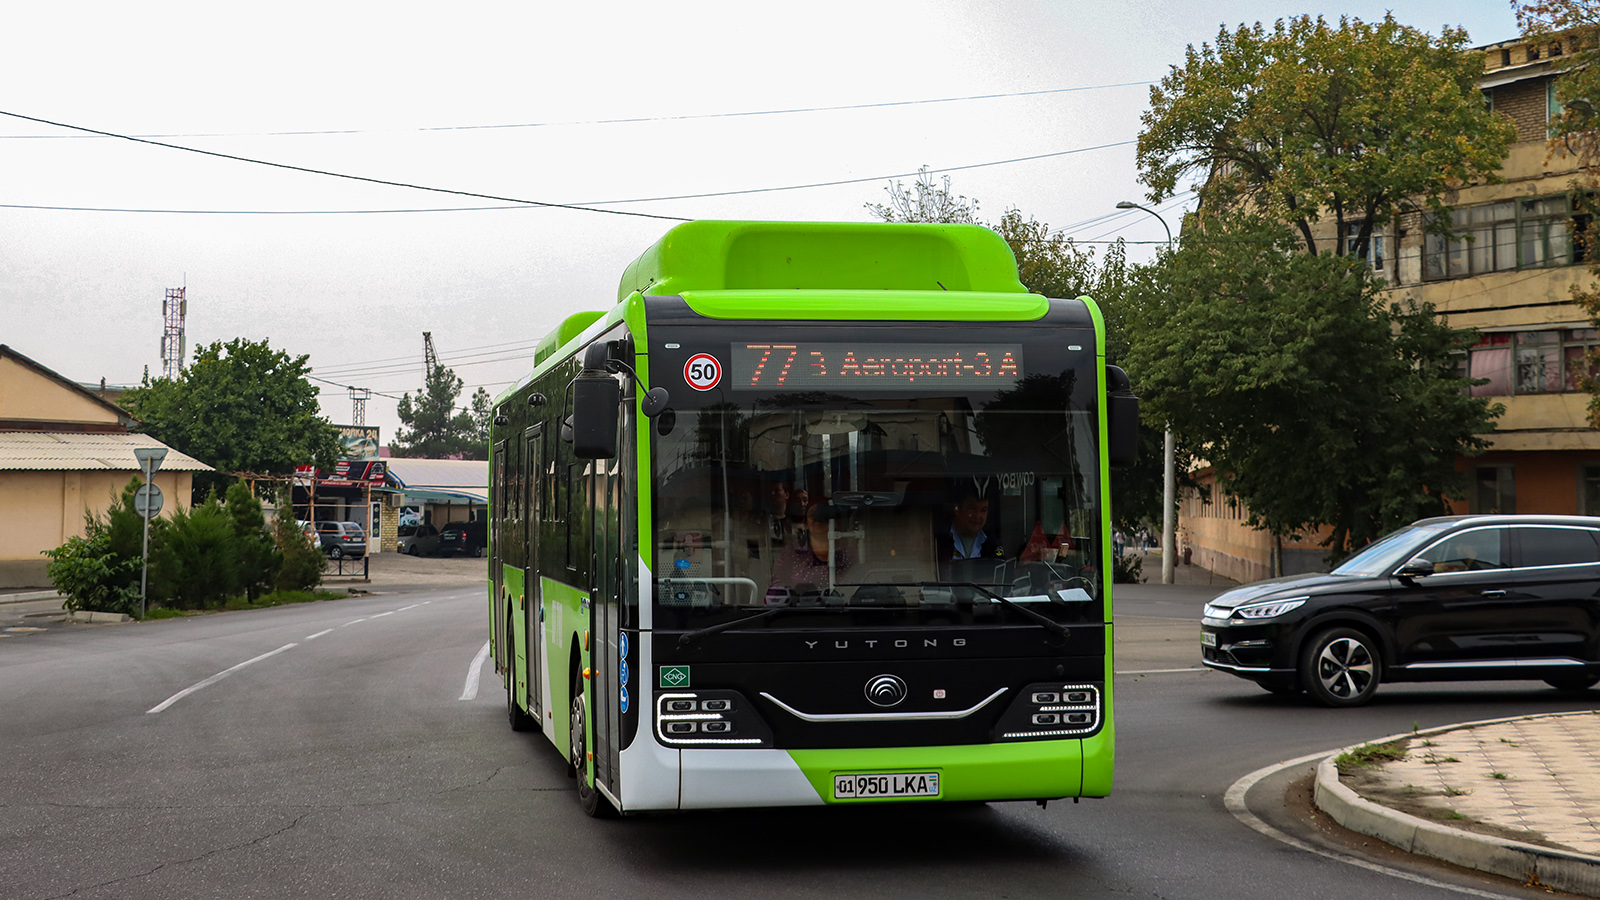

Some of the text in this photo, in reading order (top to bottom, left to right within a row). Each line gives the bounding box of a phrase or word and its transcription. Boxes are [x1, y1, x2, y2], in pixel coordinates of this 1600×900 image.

[690, 363, 715, 381] 50
[746, 344, 797, 386] 77
[840, 350, 991, 382] Aeroport-3
[366, 429, 378, 441] 24
[805, 638, 967, 649] YUTONG
[839, 776, 928, 795] 01 950 LKA
